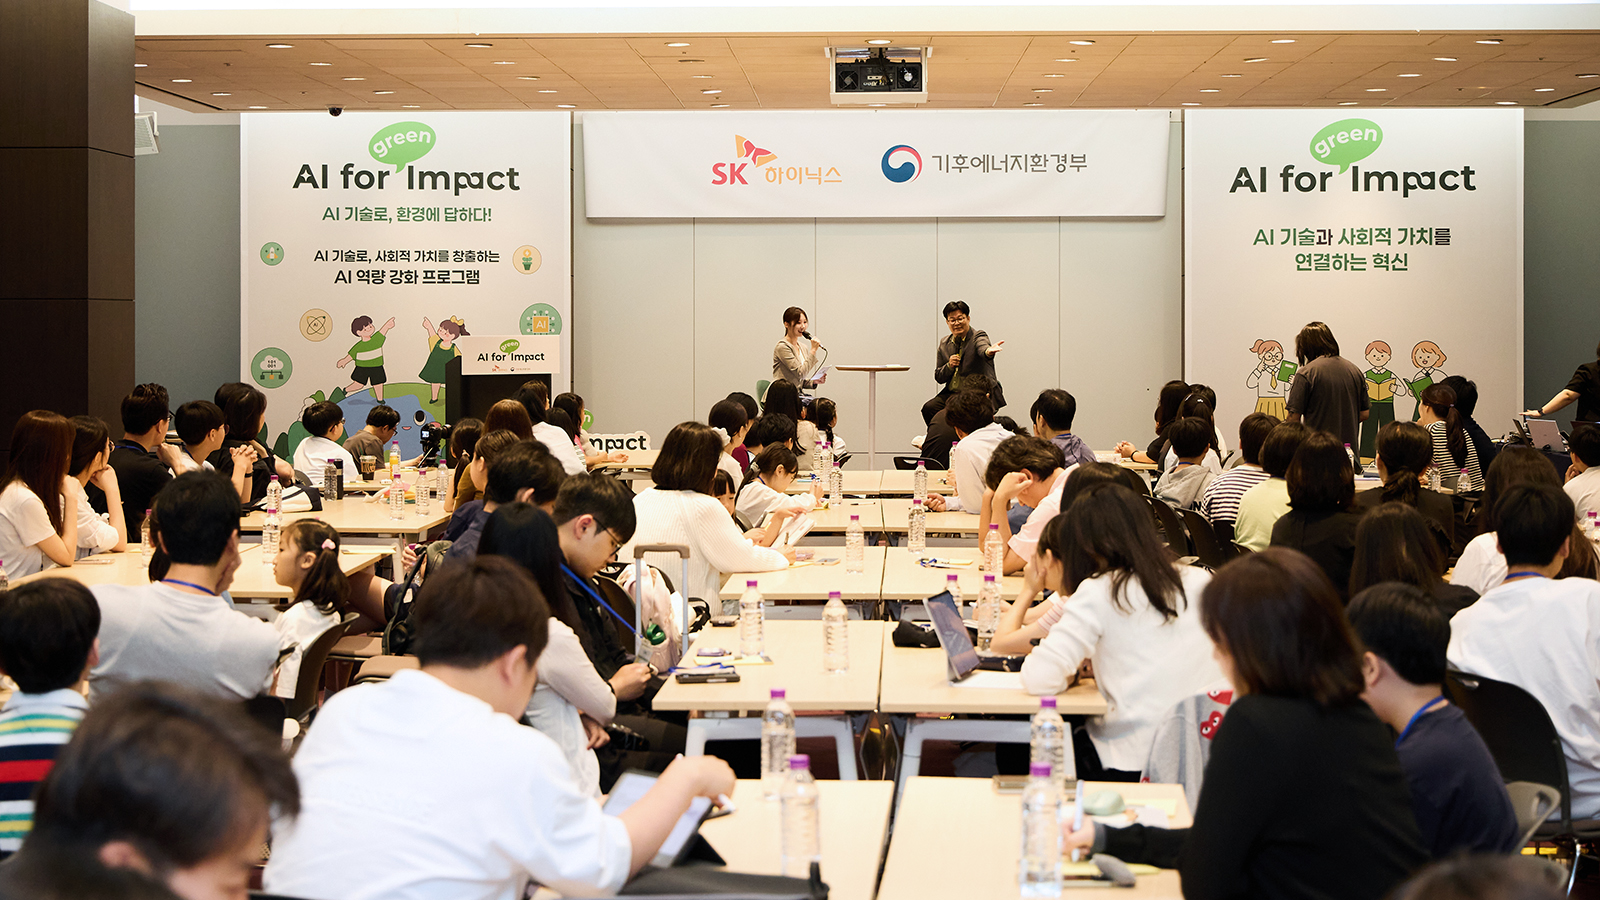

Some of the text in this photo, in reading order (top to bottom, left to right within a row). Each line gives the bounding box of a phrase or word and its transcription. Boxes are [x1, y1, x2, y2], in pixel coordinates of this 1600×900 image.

[372, 128, 432, 158] green
[1314, 127, 1378, 158] green
[931, 153, 1087, 174] 기후에너지환경부
[292, 163, 520, 196] AI for Impact
[711, 162, 842, 185] SK 하이닉스
[1229, 164, 1477, 198] AI for Impact
[322, 206, 492, 224] AI 기술로, 환경에 답하다!
[1253, 227, 1451, 246] AI 기술과 사회적 가치를
[314, 249, 500, 264] AI 기술로, 사회적 가치를 창출하는
[1295, 252, 1408, 272] 연결하는 혁신
[334, 269, 480, 285] AI 역량 강화 프로그램
[536, 320, 546, 329] AI
[501, 341, 519, 351] green
[477, 352, 545, 362] AI for Impact
[589, 436, 647, 454] mpact
